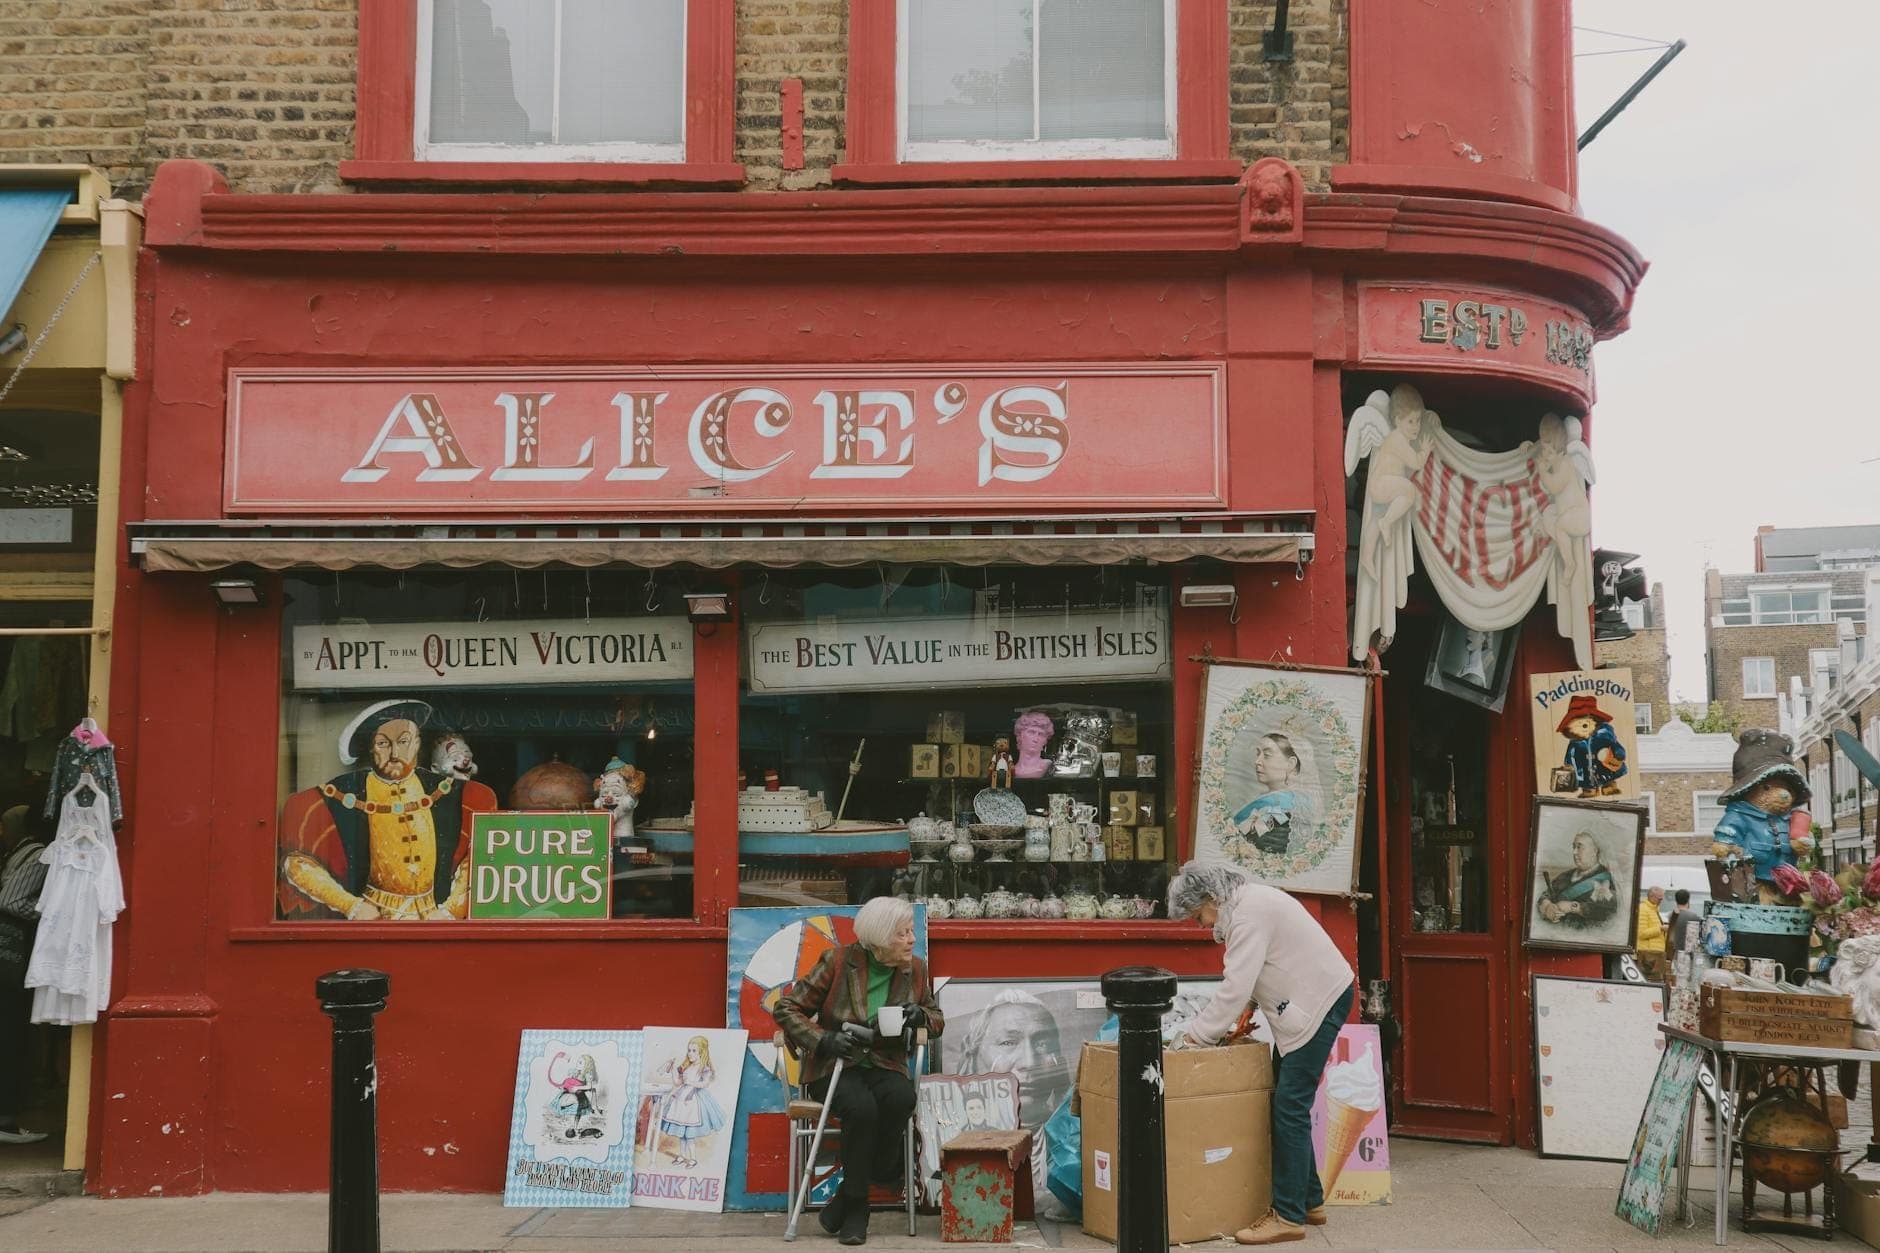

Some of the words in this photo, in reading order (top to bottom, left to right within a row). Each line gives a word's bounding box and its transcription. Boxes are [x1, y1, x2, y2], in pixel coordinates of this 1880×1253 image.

[340, 378, 1071, 487] ALICE'S
[303, 651, 314, 659] BY
[315, 637, 388, 670] APPT.
[389, 649, 399, 657] TO
[423, 633, 518, 676] QUEEN
[530, 631, 667, 665] VICTORIA
[760, 650, 791, 663] THE
[795, 637, 857, 668] BEST
[864, 634, 944, 665] VALUE
[948, 644, 961, 657] IN
[964, 643, 990, 657] THE
[994, 630, 1087, 661] BRITISH
[1095, 626, 1158, 657] ISLES
[1536, 674, 1631, 709] Paddington
[486, 828, 595, 855] PURE
[476, 865, 603, 907] DRUGS
[688, 1176, 720, 1201] ME
